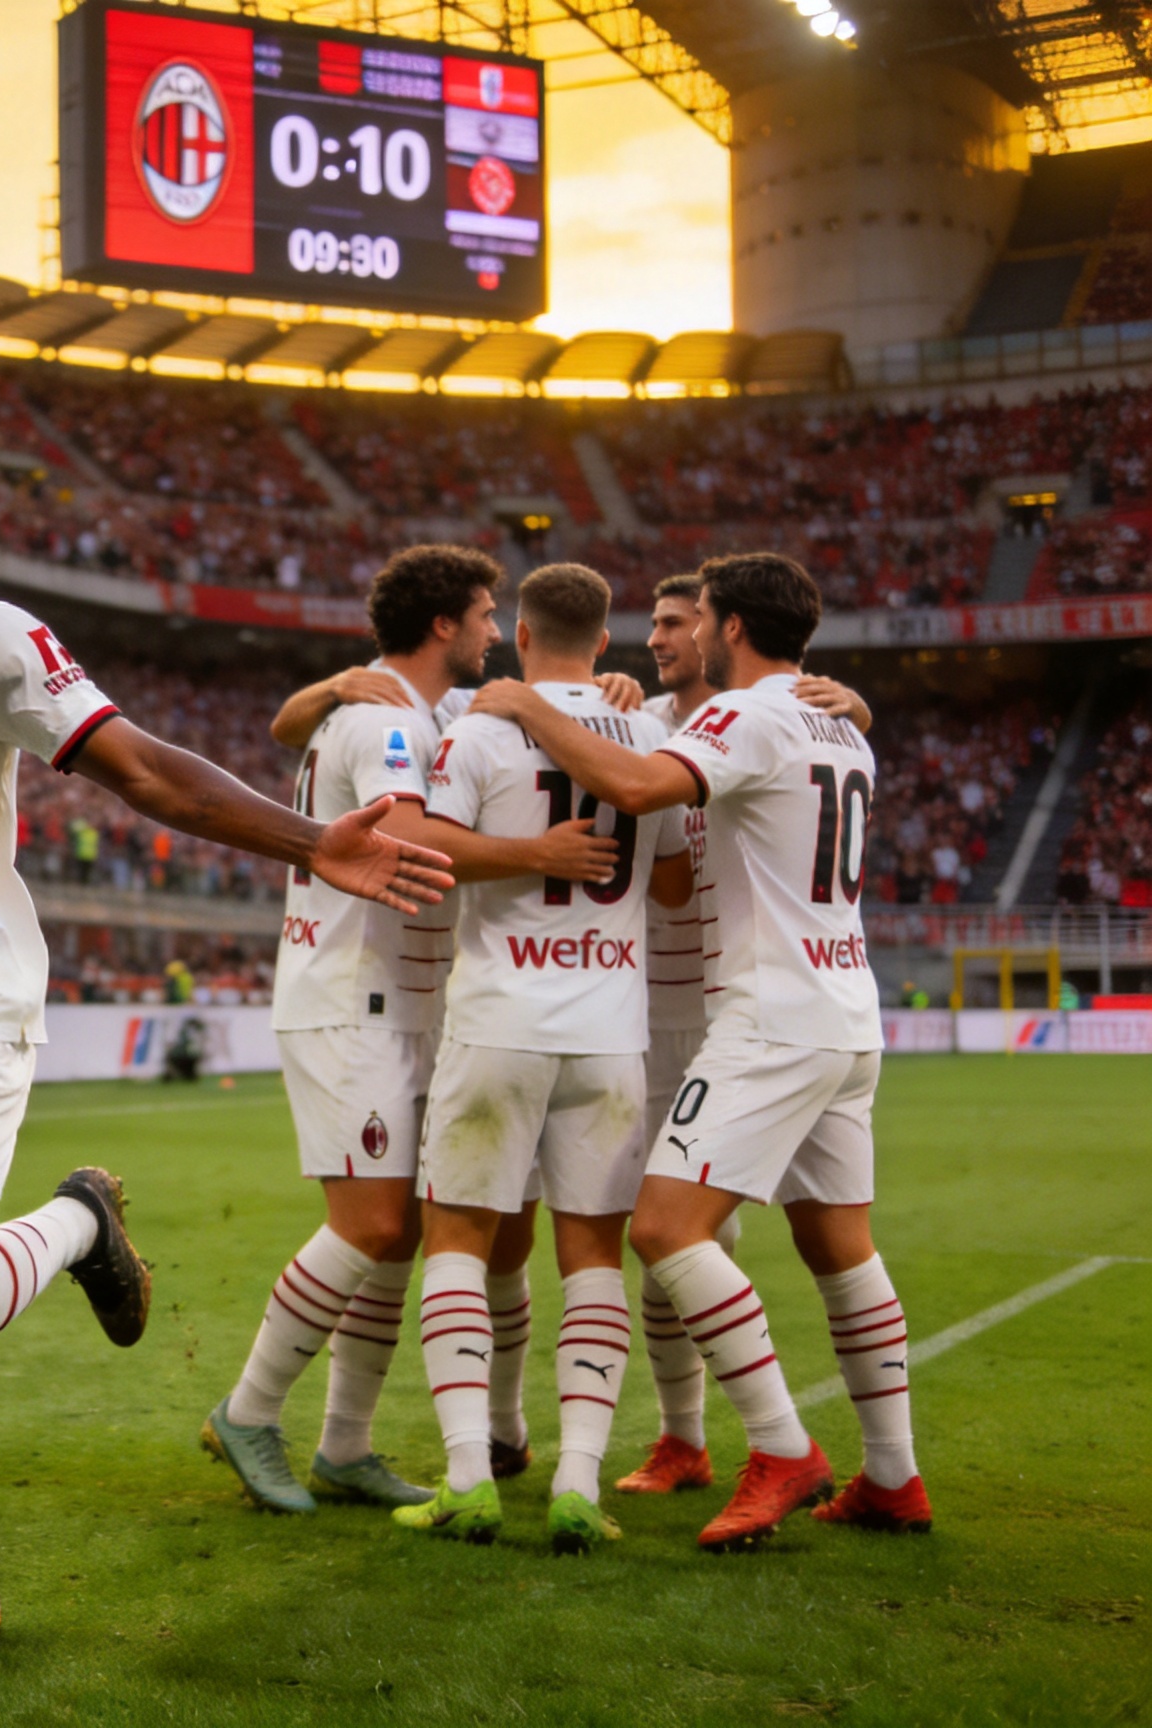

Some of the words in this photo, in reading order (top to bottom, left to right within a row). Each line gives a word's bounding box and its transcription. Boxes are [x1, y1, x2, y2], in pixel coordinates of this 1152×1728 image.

[288, 227, 400, 281] 09:30
[810, 763, 871, 905] 10
[506, 928, 637, 970] wefox
